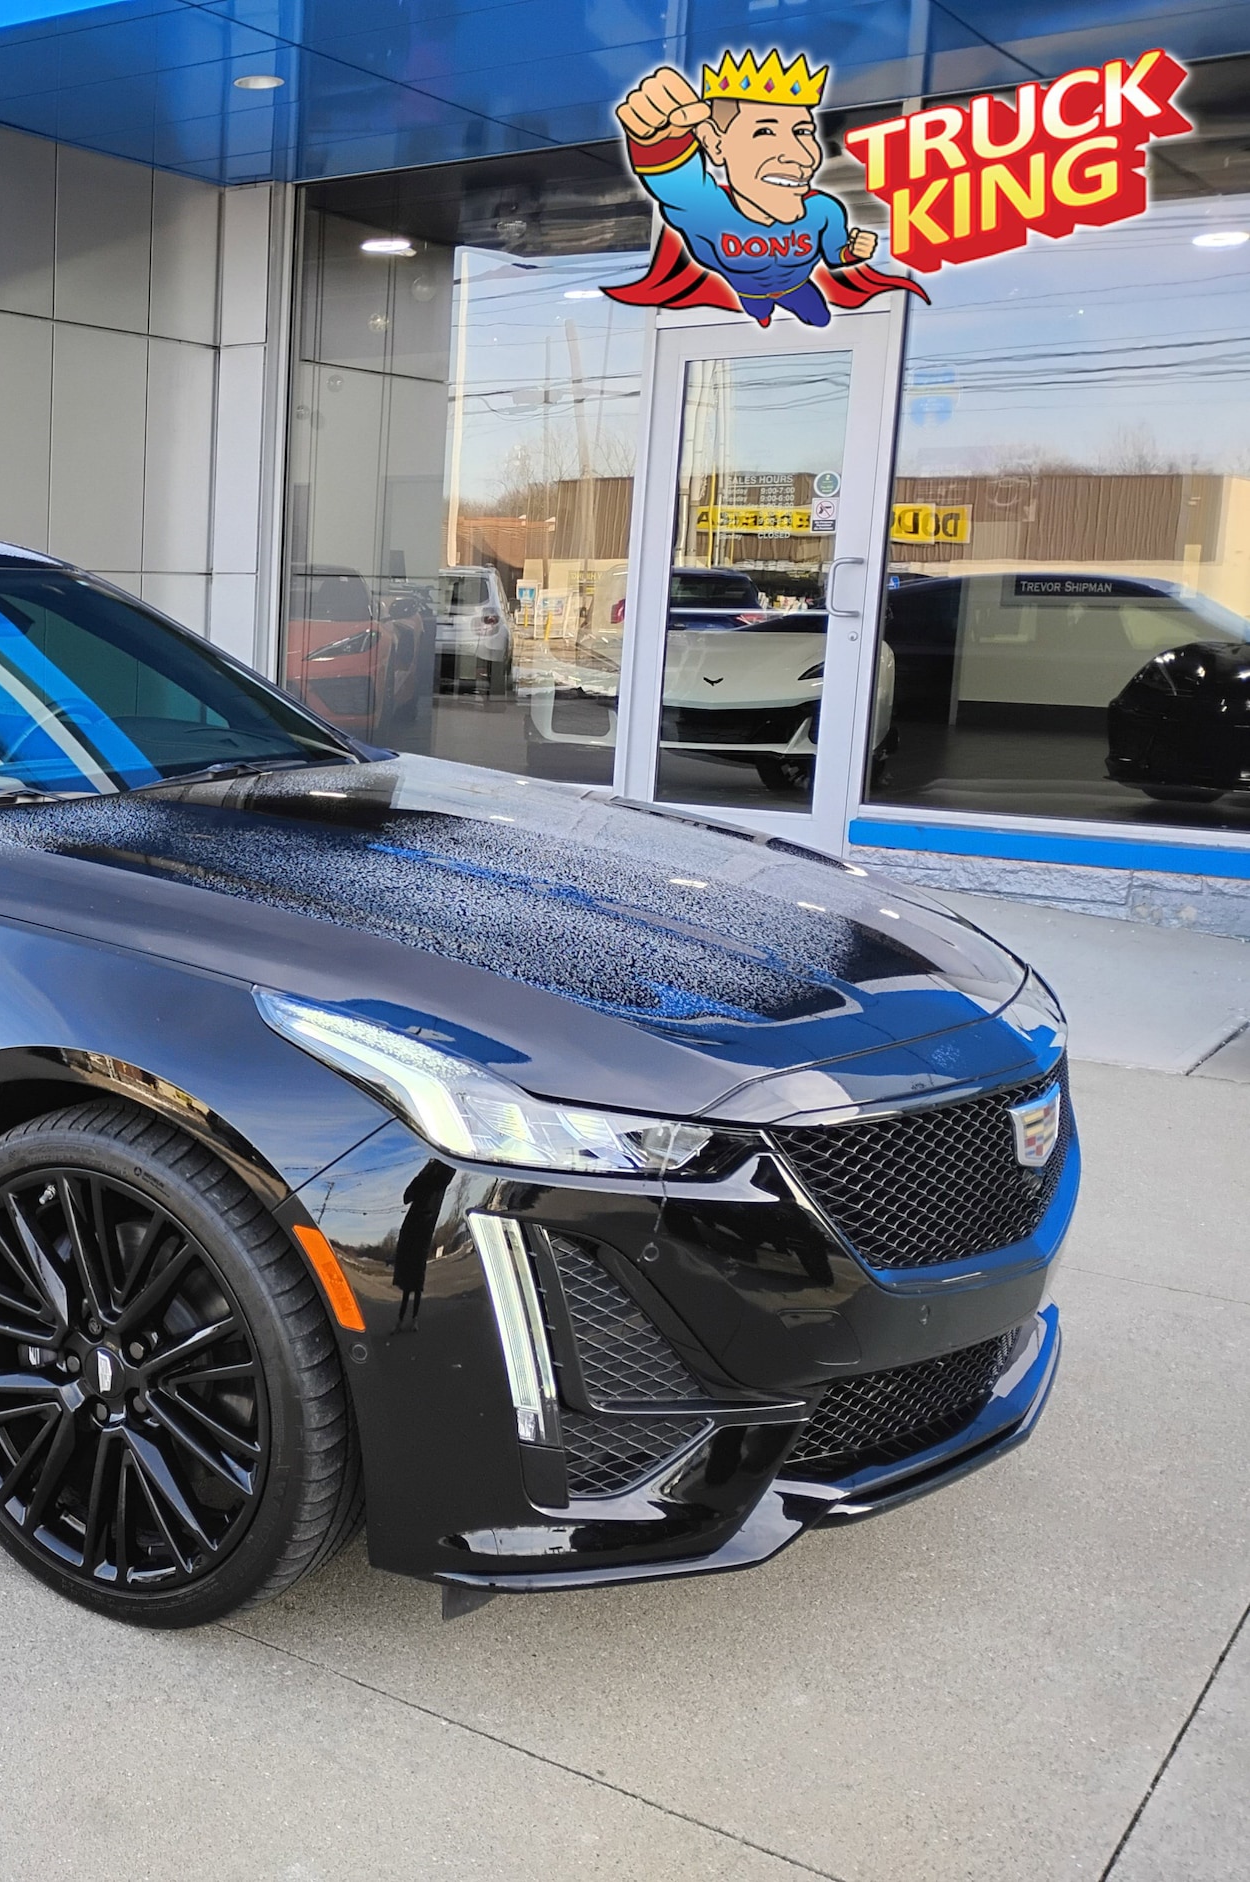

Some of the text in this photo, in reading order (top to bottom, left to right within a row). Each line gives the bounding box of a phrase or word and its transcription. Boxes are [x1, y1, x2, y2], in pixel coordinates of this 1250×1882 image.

[759, 475, 793, 484] HOURS
[758, 531, 791, 540] CLOSED
[1020, 580, 1113, 593] TREVOR SHIPMAN
